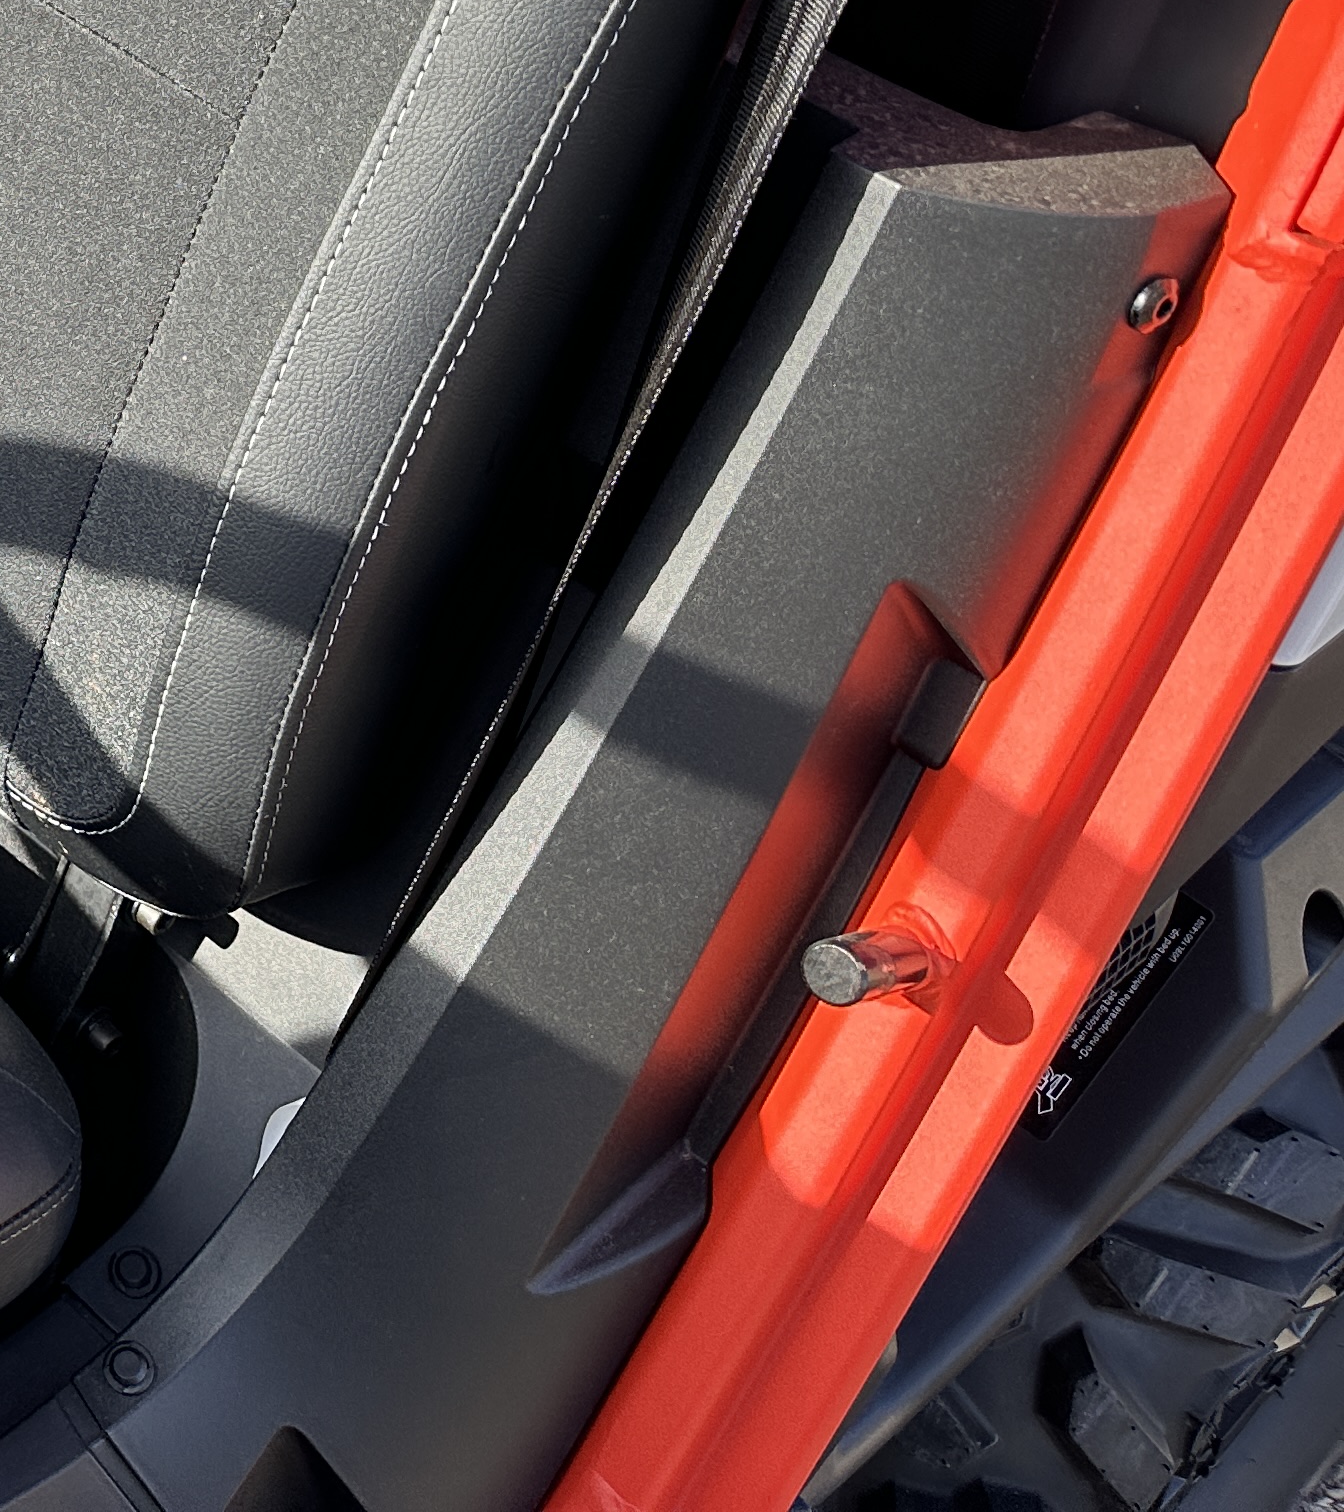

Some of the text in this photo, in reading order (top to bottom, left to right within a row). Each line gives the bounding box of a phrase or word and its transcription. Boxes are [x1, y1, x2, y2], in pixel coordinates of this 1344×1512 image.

[1070, 1028, 1088, 1050] when
[1085, 1006, 1109, 1031] closing
[1088, 1031, 1102, 1046] not
[1097, 1004, 1122, 1034] operate
[1116, 992, 1131, 1007] the
[1127, 967, 1150, 994] vehicle
[1145, 951, 1161, 969] with
[1155, 937, 1172, 954] bed
